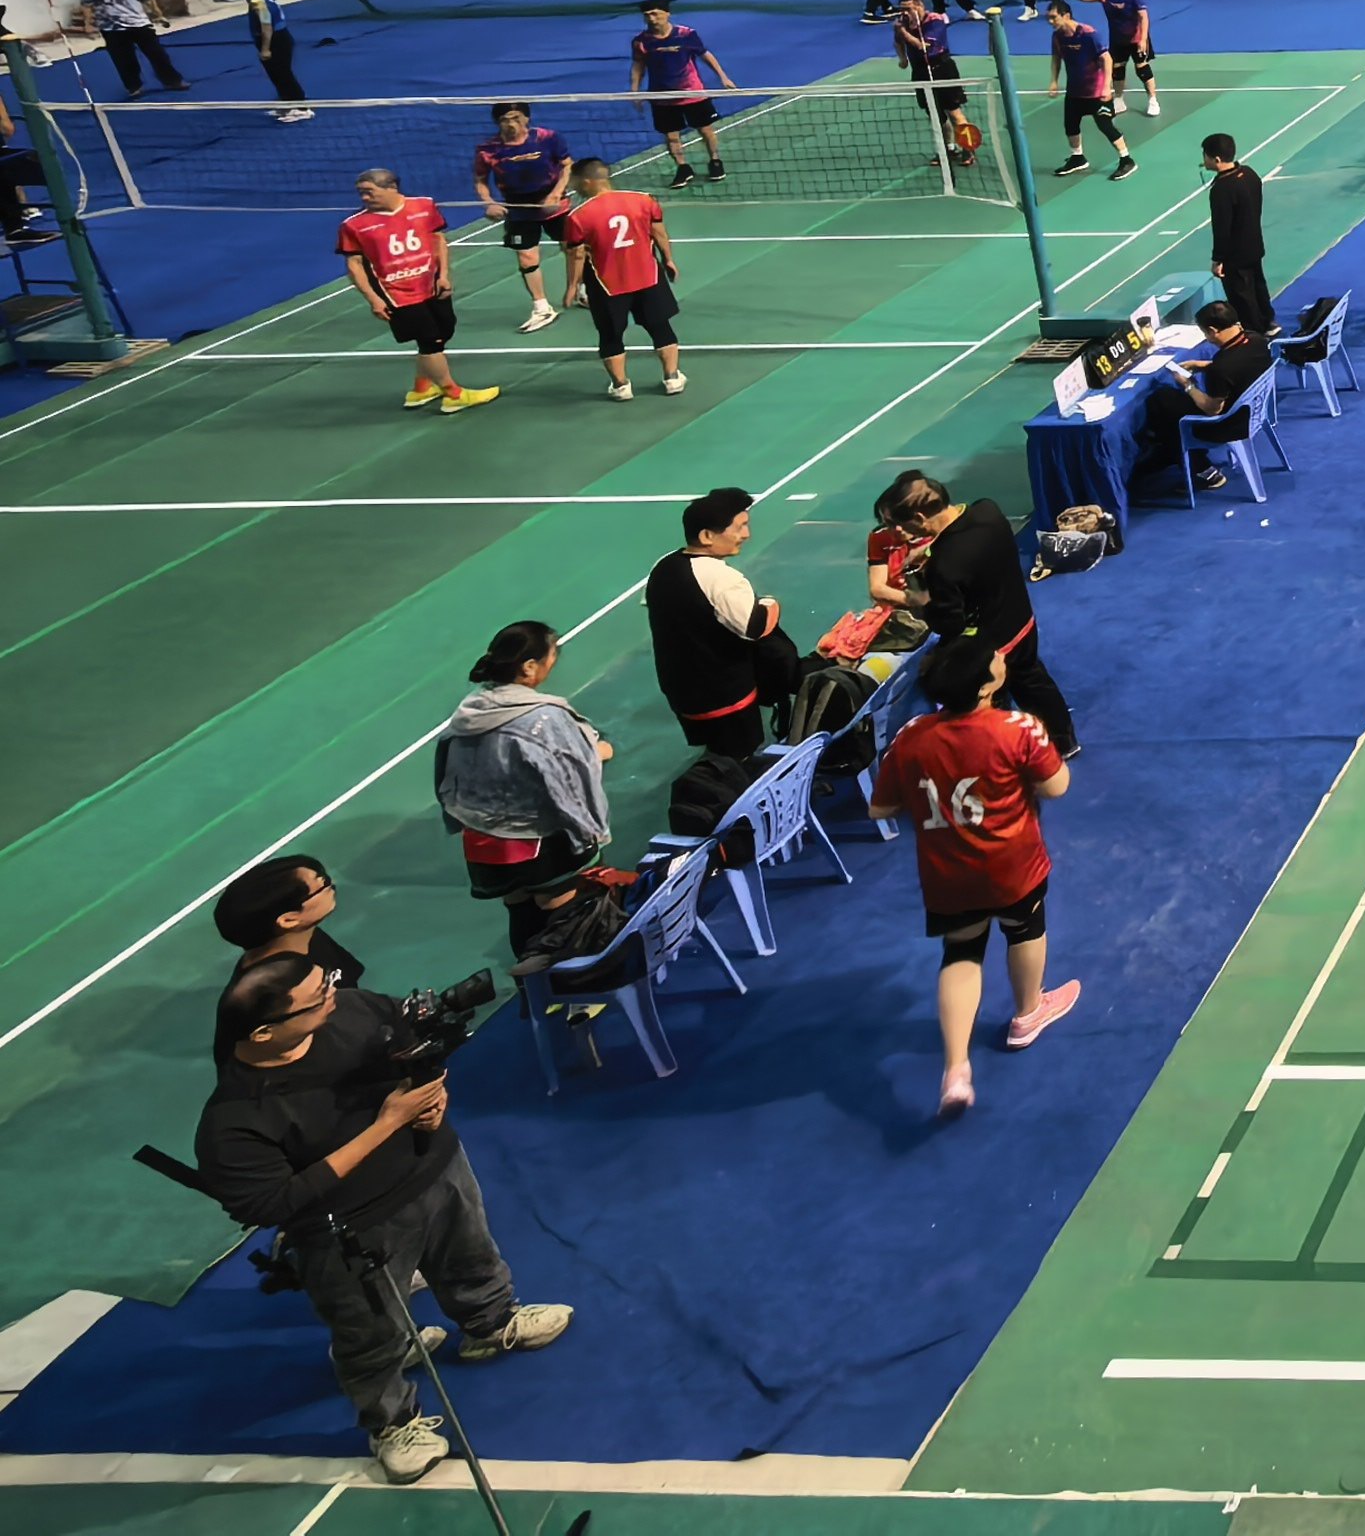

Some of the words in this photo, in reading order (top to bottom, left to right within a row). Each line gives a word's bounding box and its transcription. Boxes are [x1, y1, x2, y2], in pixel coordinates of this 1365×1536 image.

[960, 126, 973, 147] 1
[388, 228, 422, 256] 66
[608, 215, 635, 249] 2
[1096, 355, 1113, 376] 13
[1126, 331, 1141, 351] 5
[918, 776, 985, 831] 16
